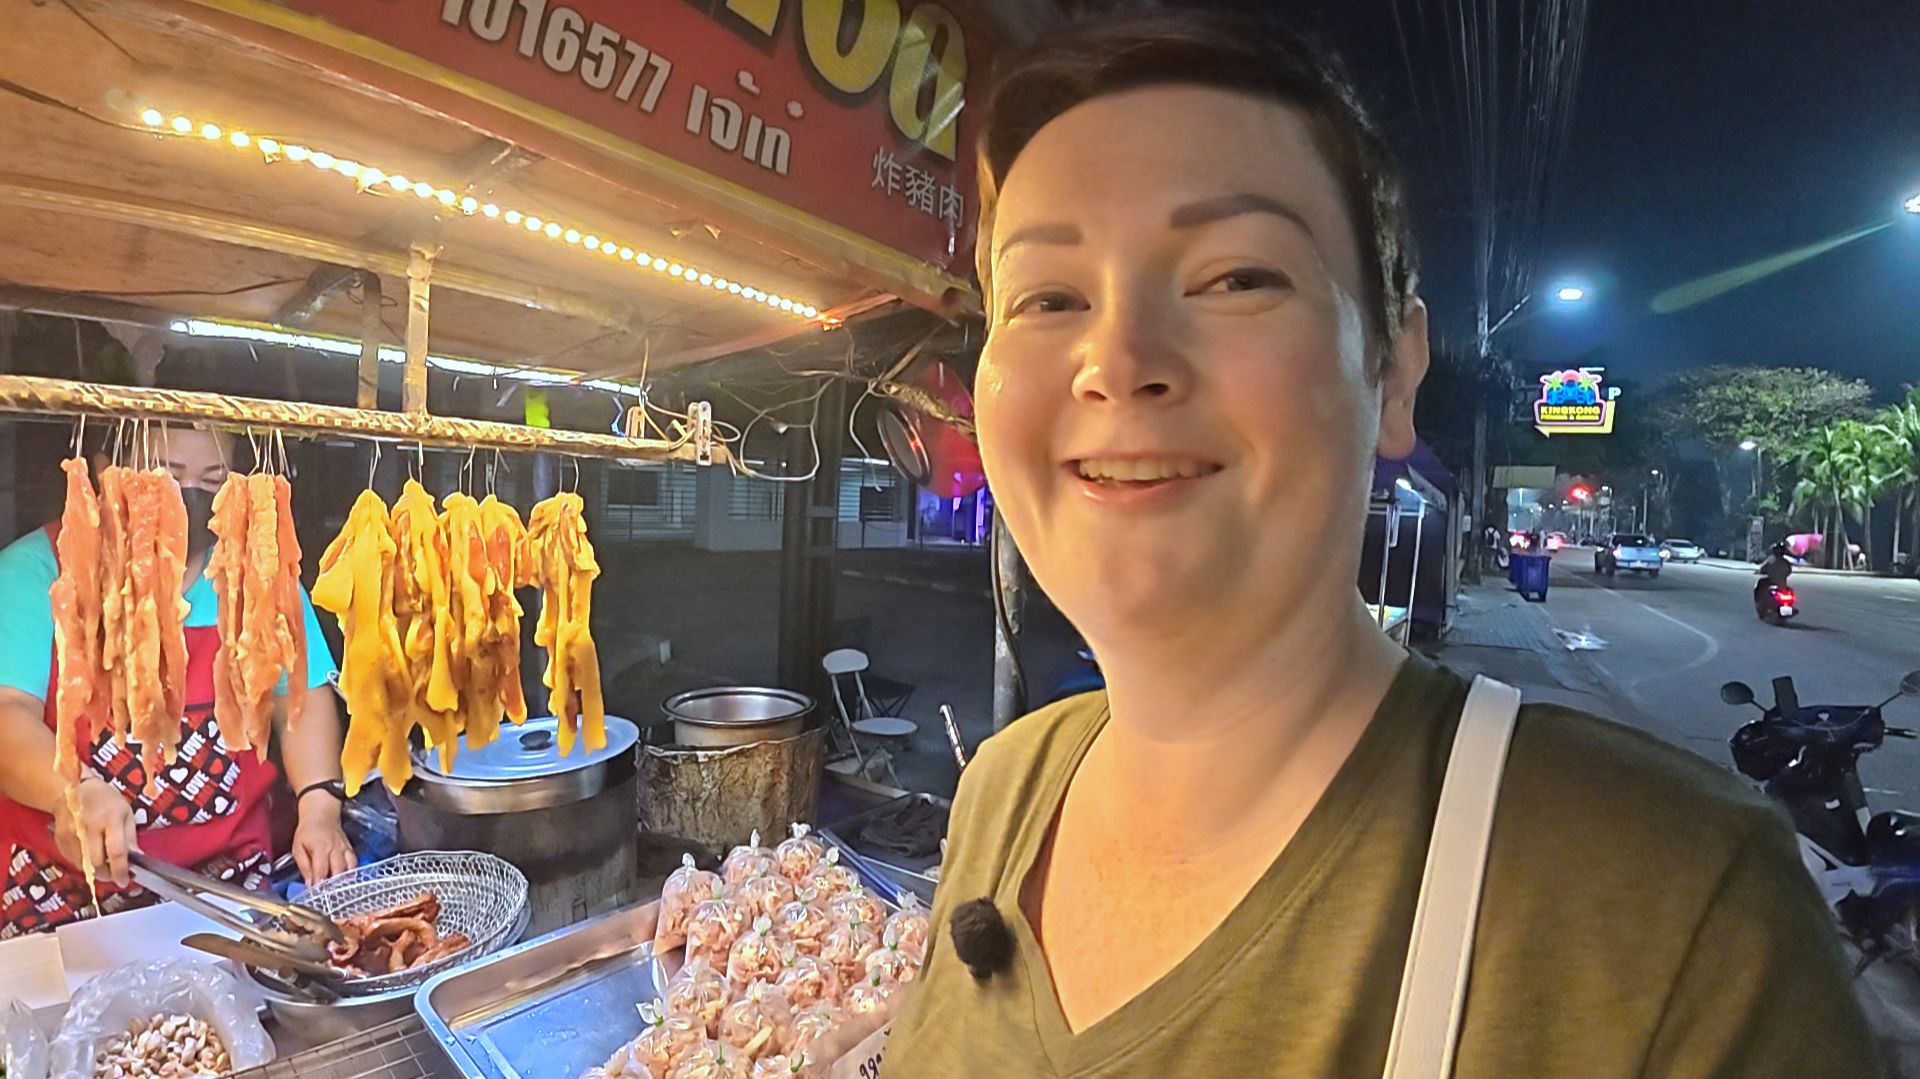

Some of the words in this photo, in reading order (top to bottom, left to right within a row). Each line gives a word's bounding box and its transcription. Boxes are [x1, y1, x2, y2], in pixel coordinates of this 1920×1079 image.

[871, 146, 964, 228] 炸豬肉
[1541, 406, 1600, 415] KINGKONG
[92, 735, 120, 767] LOV
[178, 730, 206, 763] LOVE
[181, 769, 210, 801] LOVE
[219, 761, 241, 793] LOVE
[9, 848, 32, 877] LOVE
[34, 892, 66, 913] LOVE
